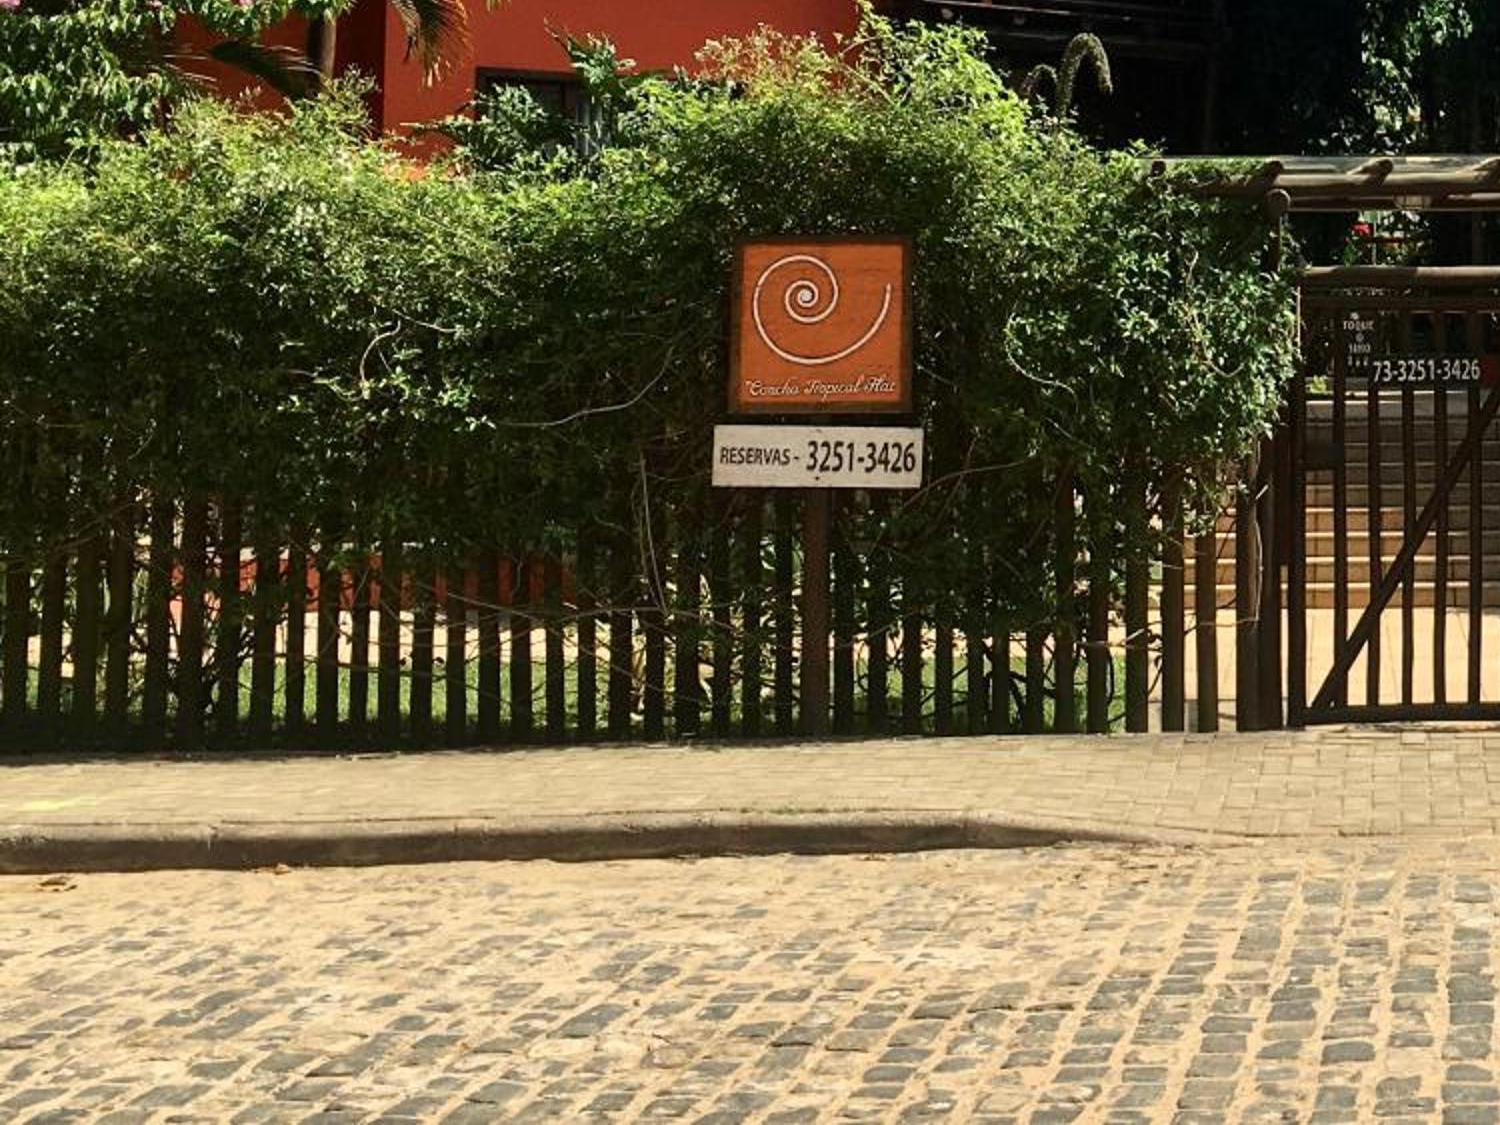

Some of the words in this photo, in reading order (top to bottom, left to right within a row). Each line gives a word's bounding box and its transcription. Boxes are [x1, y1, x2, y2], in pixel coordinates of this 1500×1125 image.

[1373, 359, 1481, 382] 73-3251-3426
[744, 377, 800, 396] Concha
[803, 374, 864, 402] Tropical
[806, 440, 916, 473] 3251-3426
